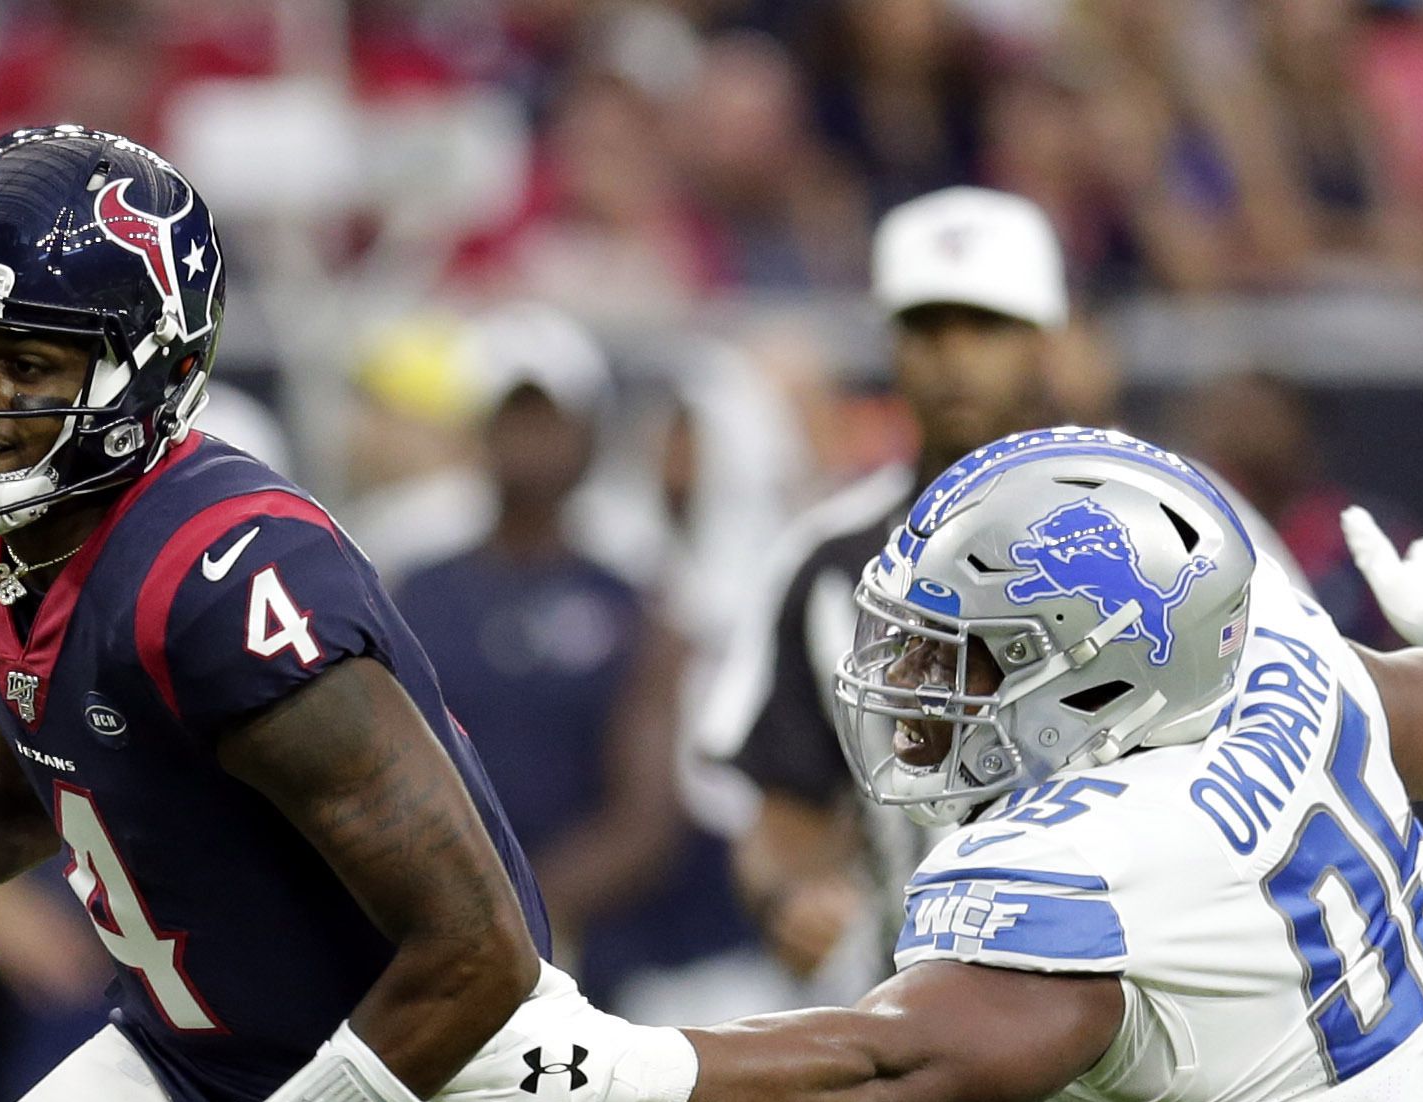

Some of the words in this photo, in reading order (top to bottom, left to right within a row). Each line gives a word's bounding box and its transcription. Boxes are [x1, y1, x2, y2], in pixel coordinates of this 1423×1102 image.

[242, 561, 326, 670] 4
[14, 738, 76, 772] TEXANS
[1190, 627, 1330, 857] OKWARA
[53, 779, 233, 1035] 4
[915, 897, 1028, 939] WCF
